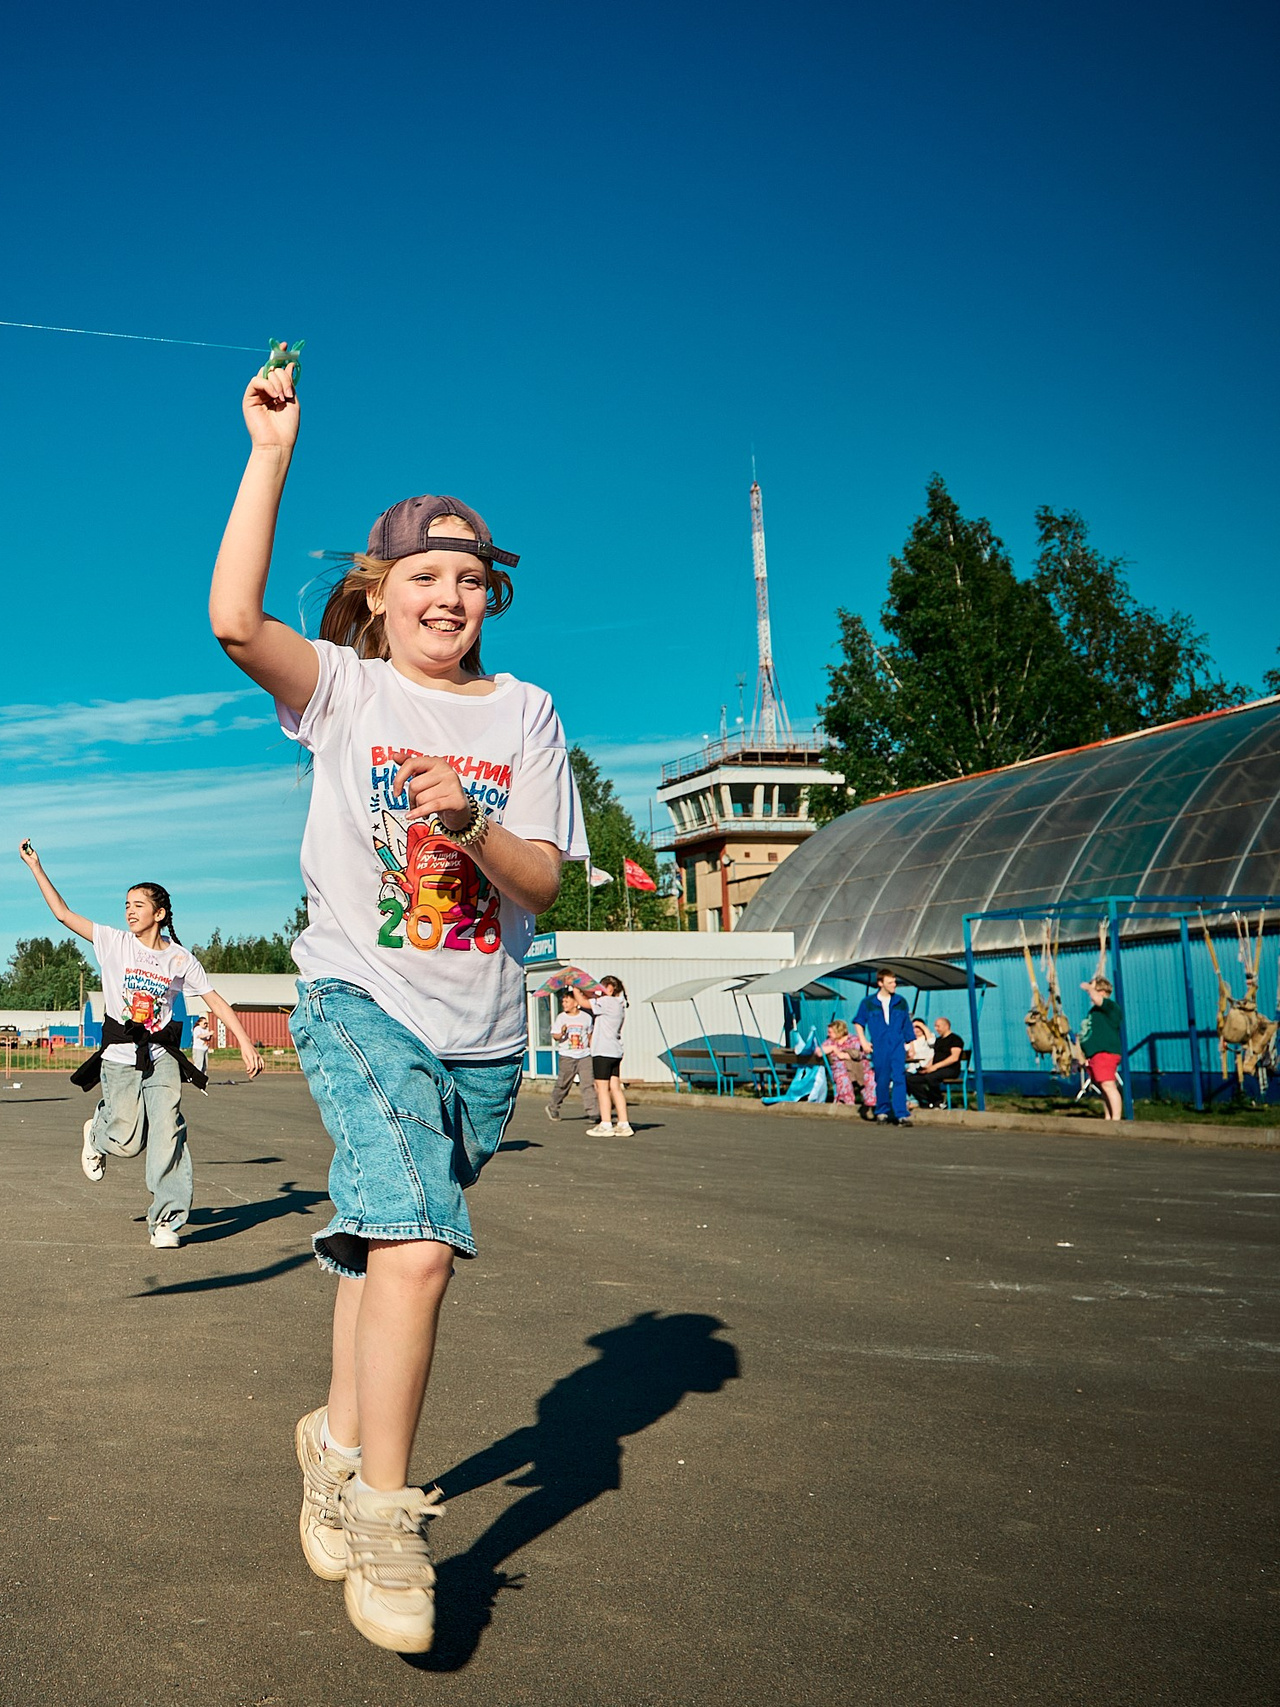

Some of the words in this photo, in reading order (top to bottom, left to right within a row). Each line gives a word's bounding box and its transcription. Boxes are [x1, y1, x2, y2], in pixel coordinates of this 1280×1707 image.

[420, 850, 458, 862] ЛУЧШИЙ
[416, 862, 428, 870] ИЗ
[429, 859, 462, 869] ЛУЧШИХ
[377, 897, 501, 954] 2026
[125, 967, 172, 985] ВЫПУСКНИК
[127, 982, 163, 997] ШКОЛЫ
